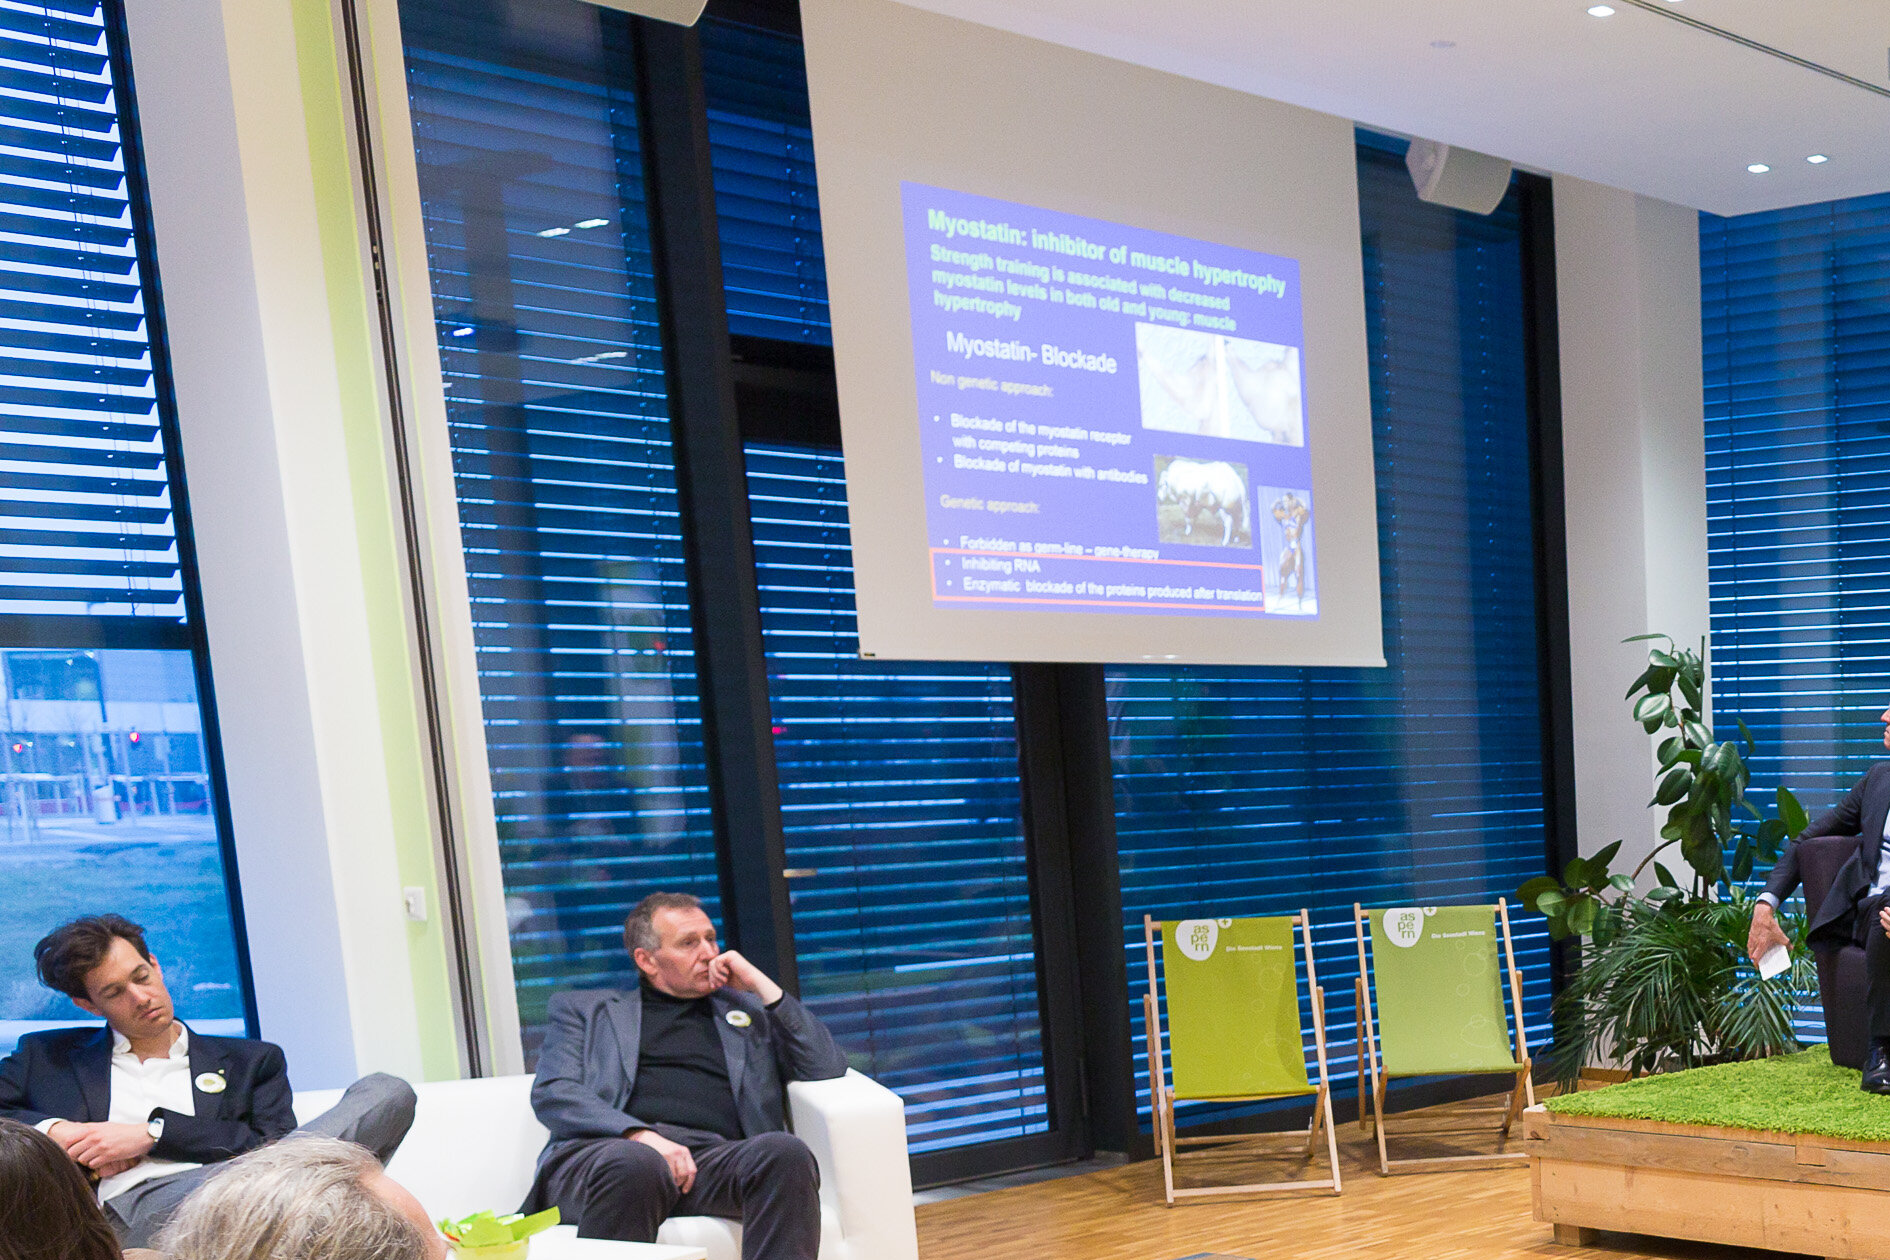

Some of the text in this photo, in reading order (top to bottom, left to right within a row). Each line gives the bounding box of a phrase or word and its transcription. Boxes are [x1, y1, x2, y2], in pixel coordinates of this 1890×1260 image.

[928, 208, 1286, 298] Myostatin: inhibitor of muscle hypertrophy
[930, 244, 1230, 311] Strength training is associated with decreased
[932, 270, 1005, 293] myostatin
[1007, 279, 1047, 300] levels
[1050, 286, 1064, 303] in
[1065, 288, 1097, 308] both
[1098, 295, 1120, 312] old
[1122, 301, 1147, 316] and
[1193, 313, 1236, 331] muscle
[934, 289, 1022, 321] hypertrophy
[1041, 343, 1117, 374] Blockade
[930, 370, 955, 385] Non
[957, 376, 999, 391] genetic
[951, 413, 1131, 446] Blockade of the myostatin receptor
[952, 435, 1080, 459] with competing proteins
[954, 453, 1149, 484] Blockade of myostatin with antibodies
[940, 494, 984, 510] Genetic
[960, 535, 1017, 552] Forbidden
[1019, 542, 1033, 553] as
[962, 557, 1041, 575] Inhibiting RNA
[963, 576, 1262, 601] Enzymatic blockade of the proteins produced after translation
